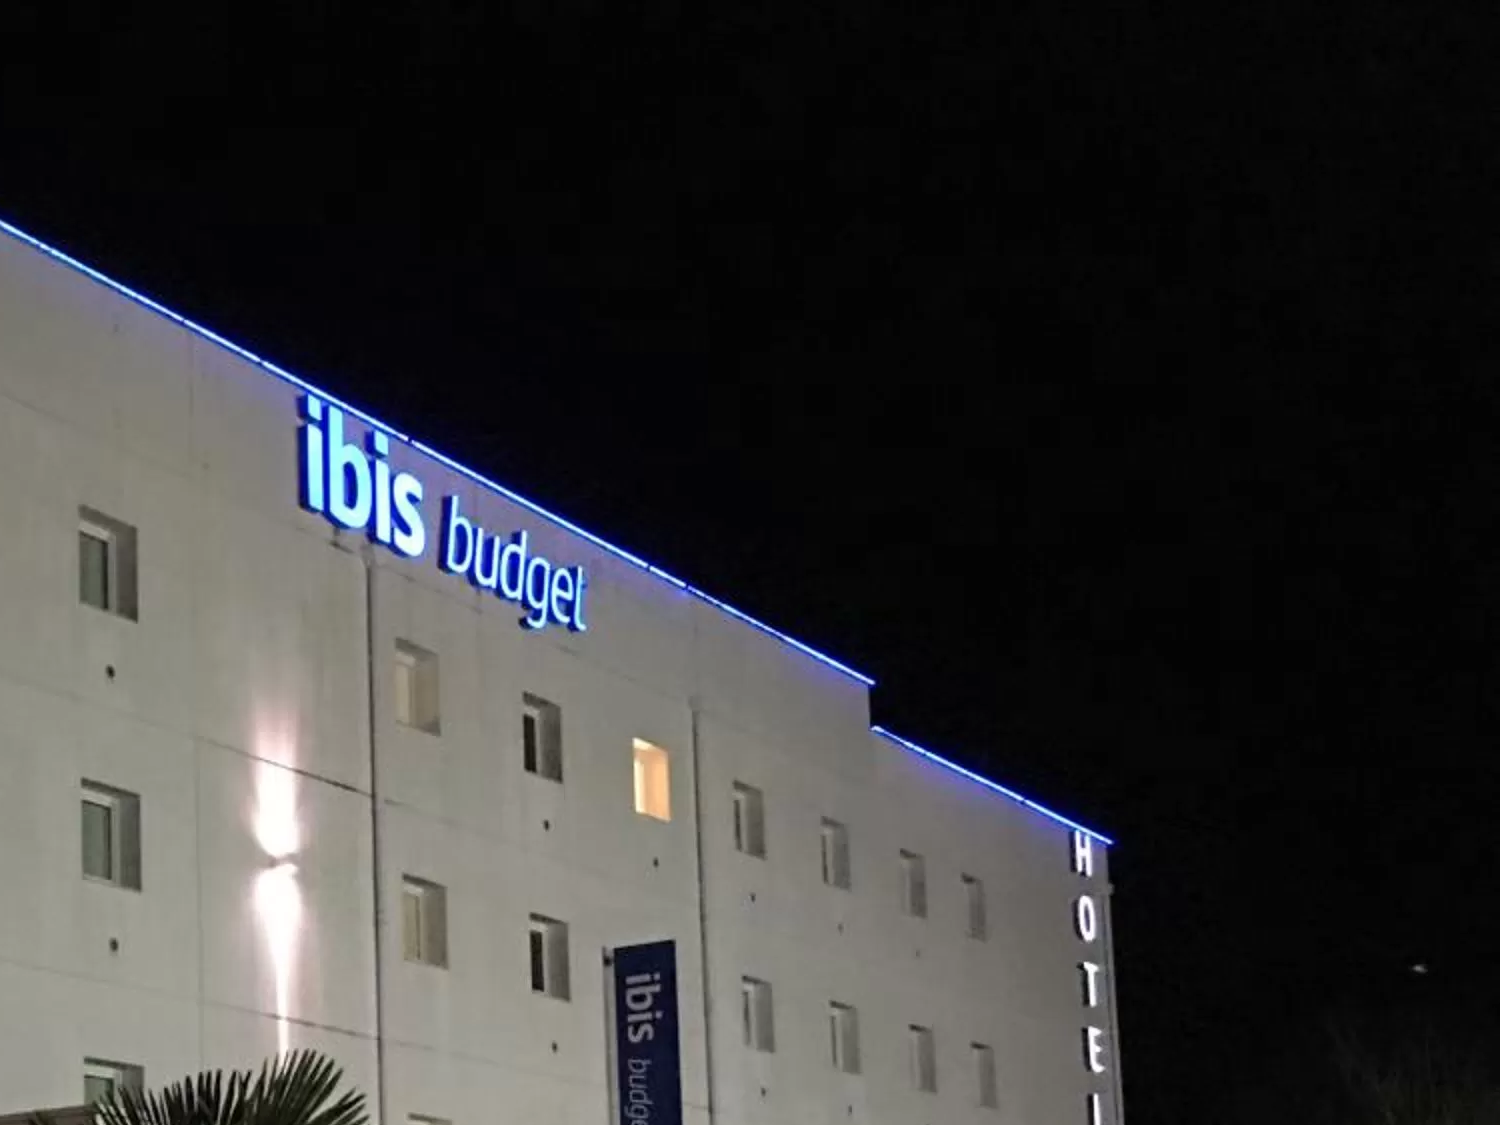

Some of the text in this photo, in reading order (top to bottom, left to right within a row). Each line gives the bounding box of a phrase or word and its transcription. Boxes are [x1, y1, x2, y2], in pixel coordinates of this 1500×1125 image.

[304, 392, 588, 632] ibis budget
[625, 972, 663, 1044] ibis
